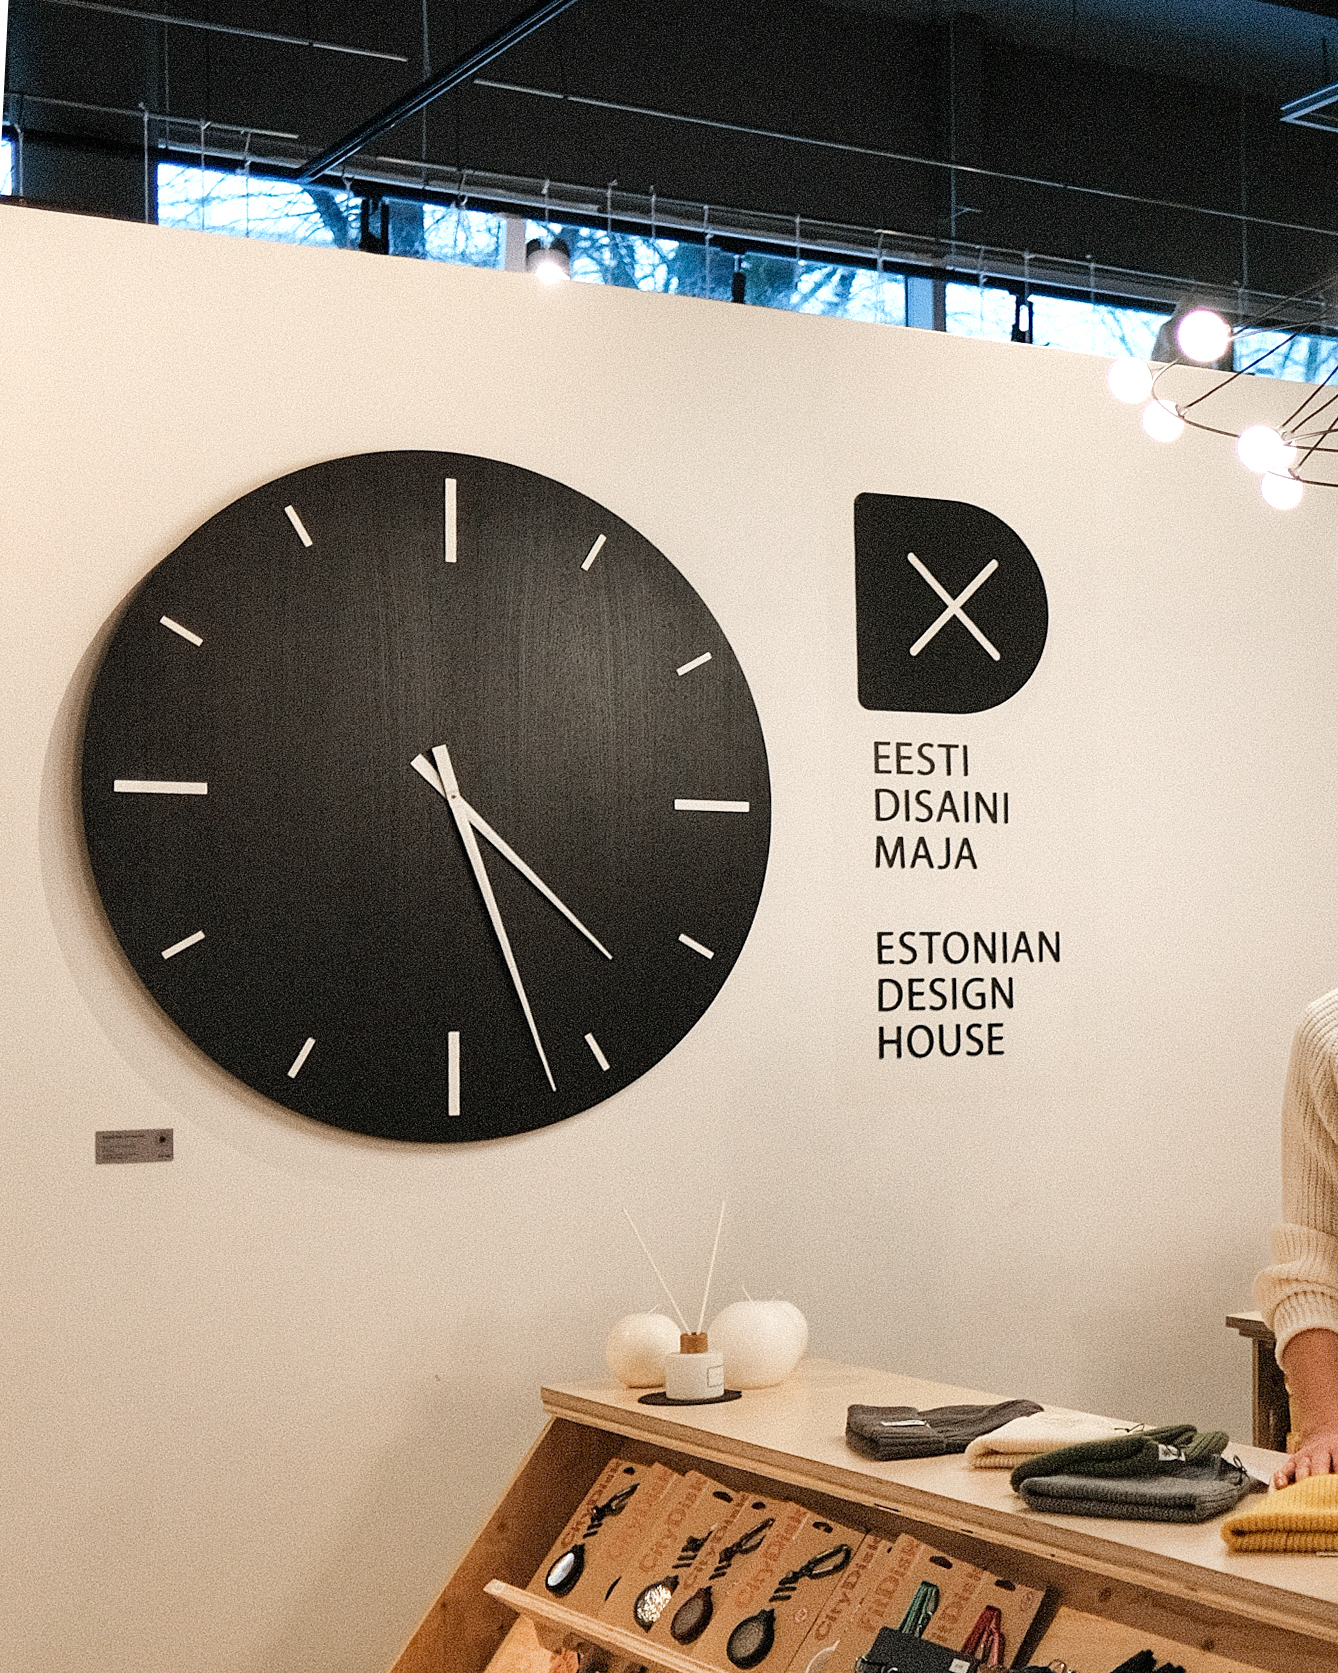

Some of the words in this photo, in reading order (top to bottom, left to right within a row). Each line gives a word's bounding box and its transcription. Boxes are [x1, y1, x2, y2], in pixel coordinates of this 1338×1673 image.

[873, 741, 969, 776] EESTI
[874, 788, 1009, 824] DISAINI
[875, 836, 978, 870] MAJA
[876, 931, 1061, 964] ESTONIAN
[877, 976, 1014, 1011] DESIGN
[878, 1023, 1004, 1059] HOUSE
[638, 1478, 709, 1573] CityDisk
[815, 1537, 881, 1641] CityDisk
